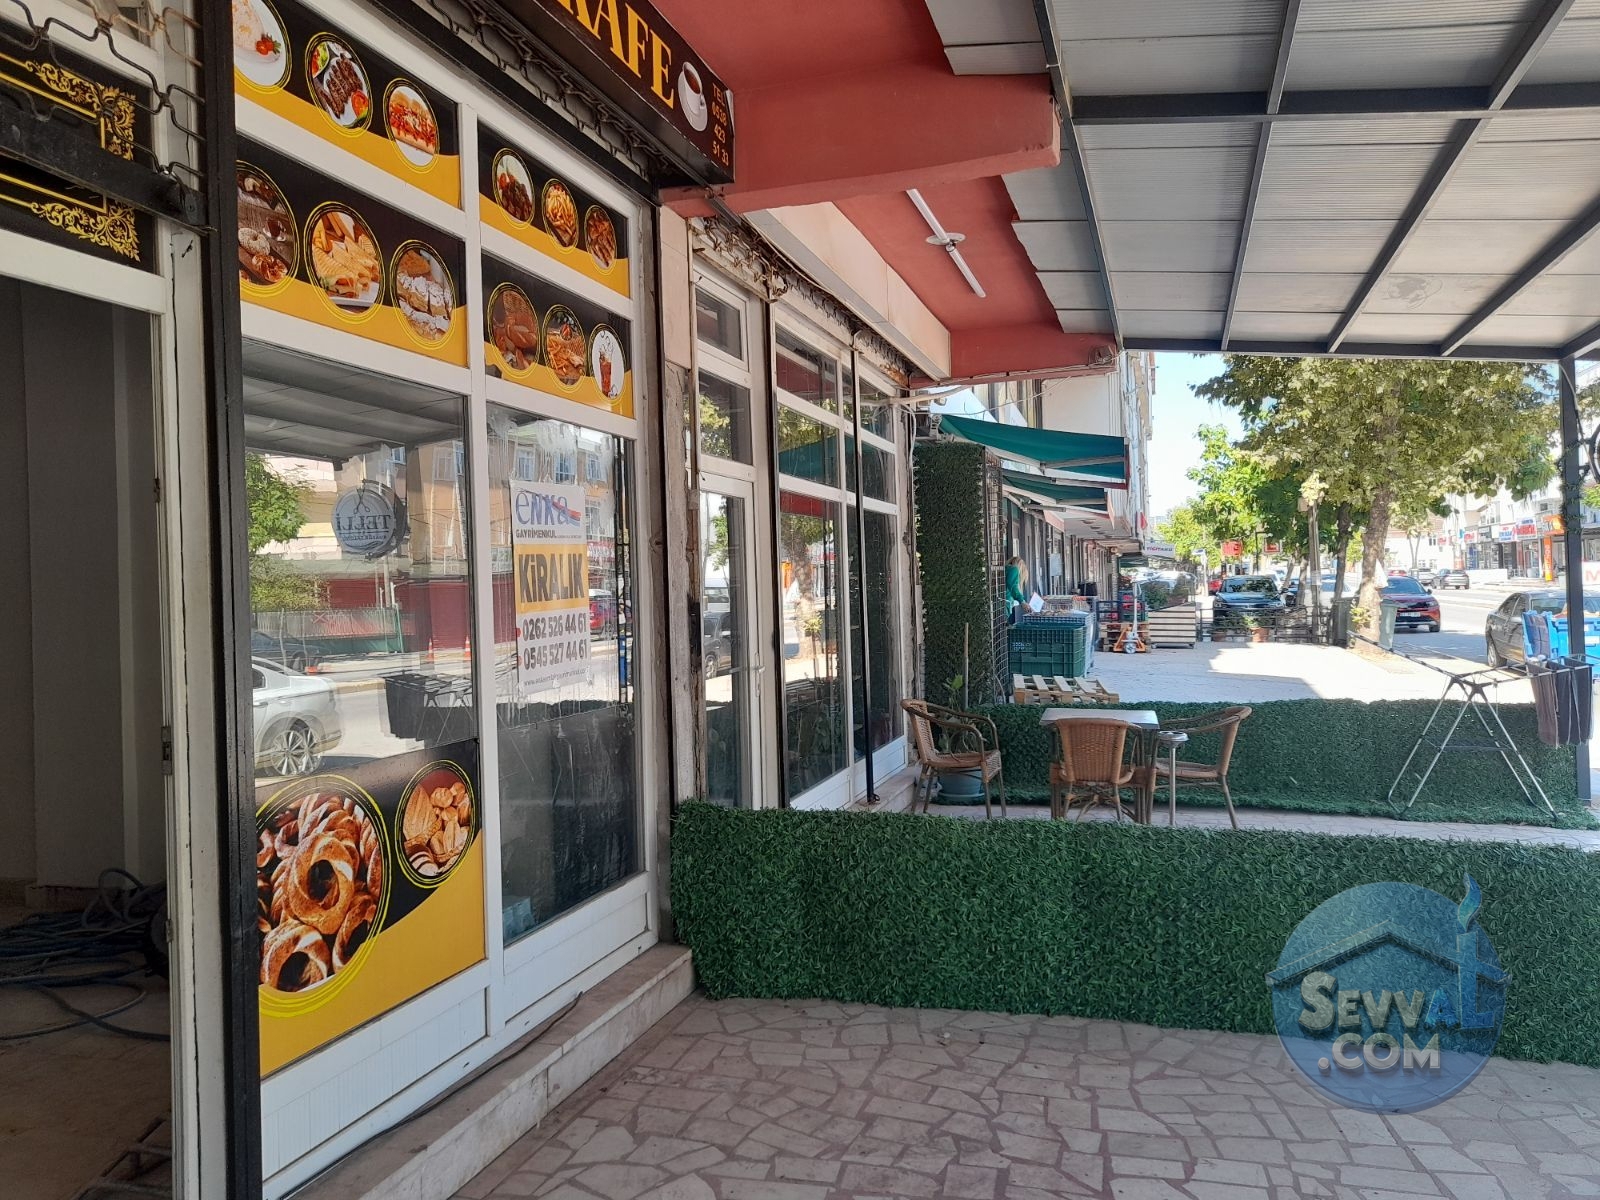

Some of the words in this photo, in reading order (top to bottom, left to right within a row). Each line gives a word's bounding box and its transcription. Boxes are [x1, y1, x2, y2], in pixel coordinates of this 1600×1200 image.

[556, 0, 674, 109] AFE
[713, 140, 720, 157] 51
[714, 124, 726, 143] 423
[519, 554, 585, 603] KİRALIK
[523, 617, 547, 641] 0262
[548, 615, 563, 638] 526
[565, 613, 577, 635] 44
[578, 612, 587, 634] 61
[524, 645, 547, 670] 0545
[549, 643, 564, 666] 527
[566, 640, 577, 662] 44
[579, 638, 588, 660] 61
